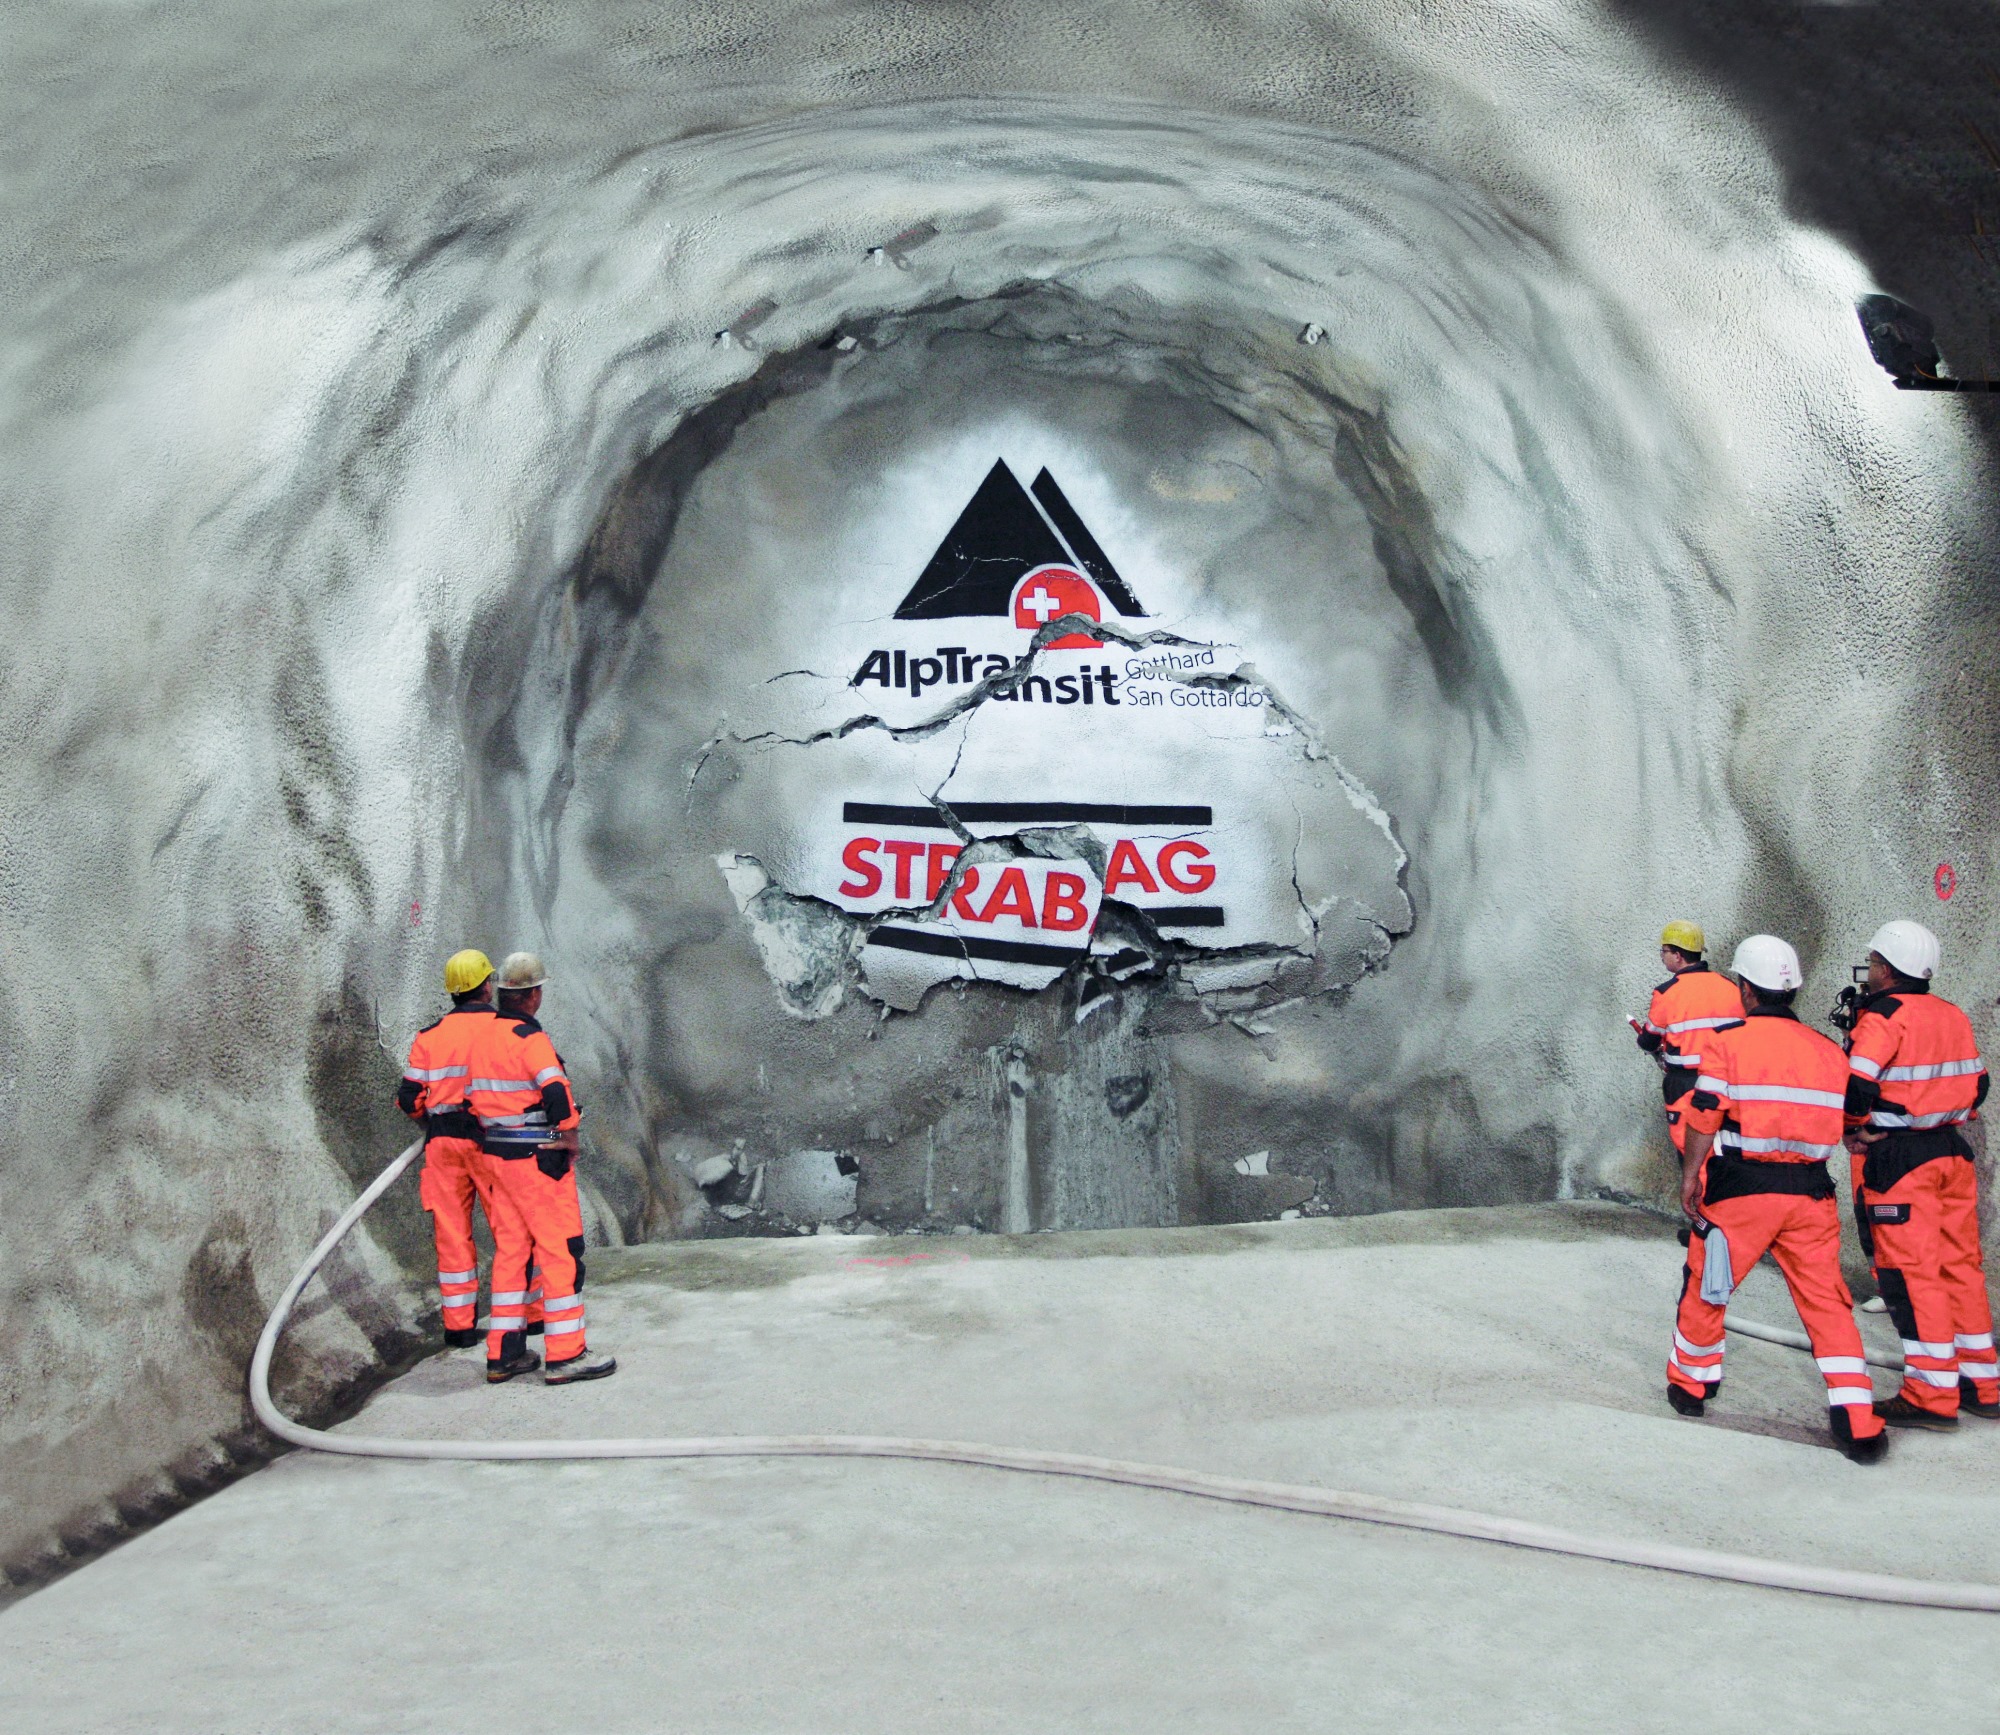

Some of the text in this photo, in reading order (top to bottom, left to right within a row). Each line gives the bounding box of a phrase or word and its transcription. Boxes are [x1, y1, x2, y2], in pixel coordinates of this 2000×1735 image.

[848, 647, 1121, 705] AlpTransit
[1125, 641, 1214, 681] Gotthard
[1127, 686, 1263, 707] San Gottardo
[838, 837, 1216, 932] STRABAG
